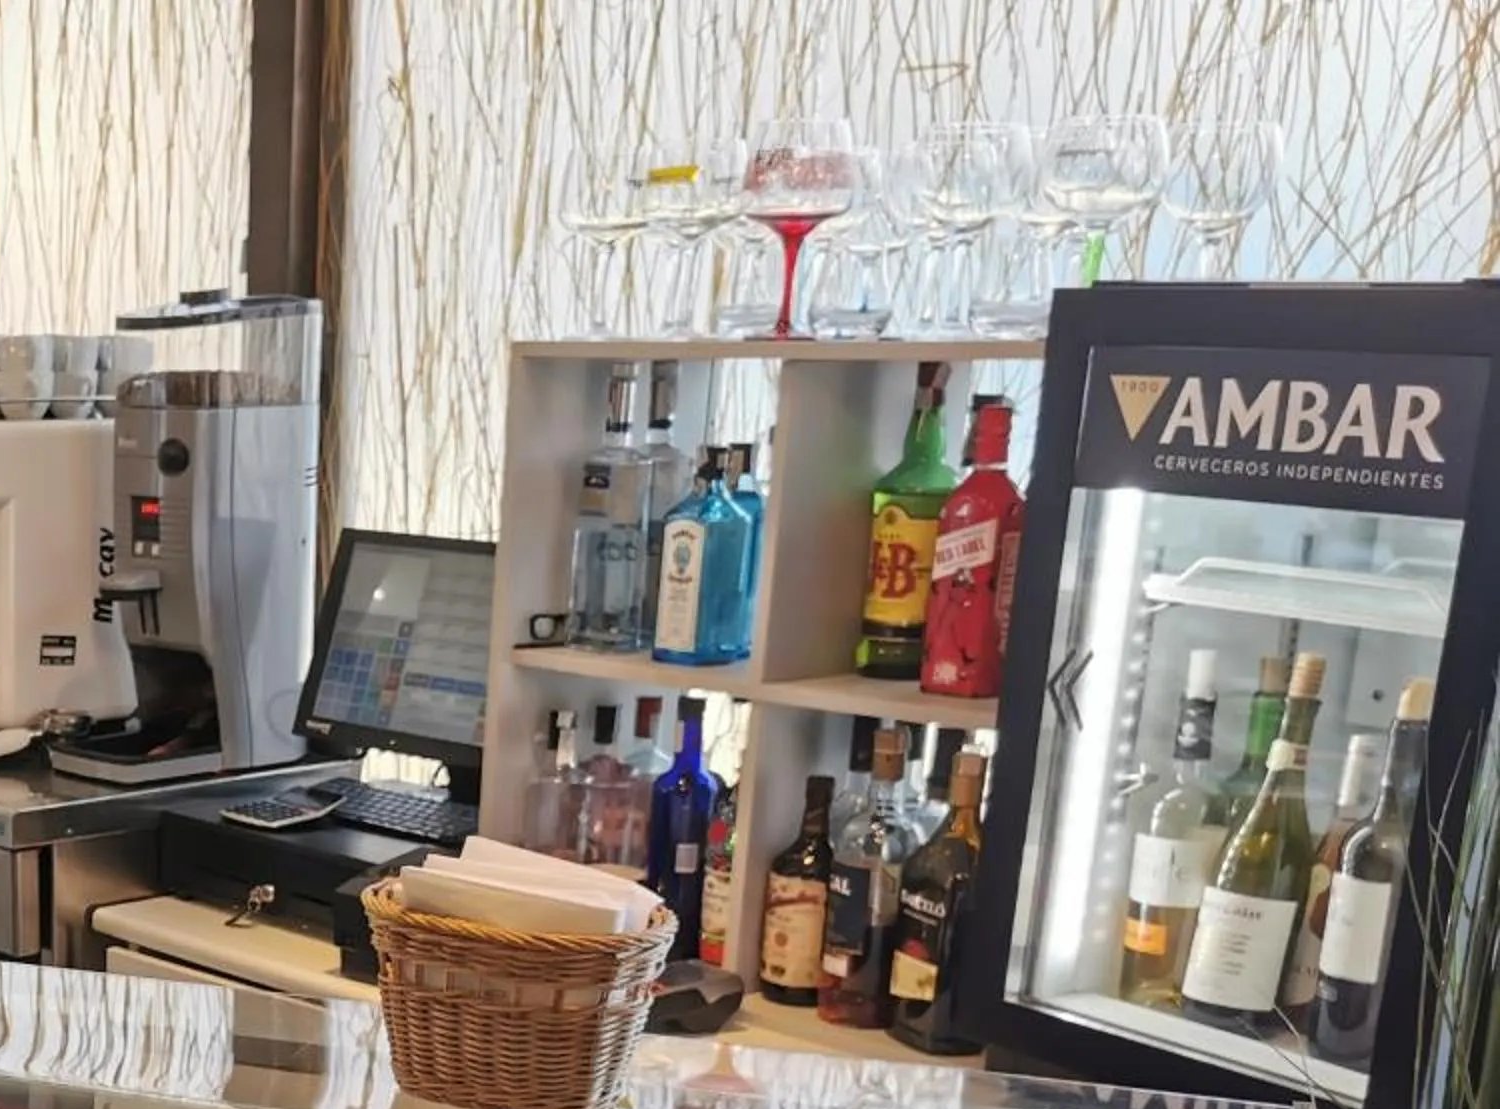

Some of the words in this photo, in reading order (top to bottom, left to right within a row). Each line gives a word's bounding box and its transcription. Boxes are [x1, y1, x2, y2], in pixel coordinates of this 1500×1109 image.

[1158, 376, 1445, 463] AMBAR
[1154, 455, 1269, 478] CERVECEROS
[1276, 464, 1445, 490] INDEPENDIENTES
[93, 527, 115, 623] mcay
